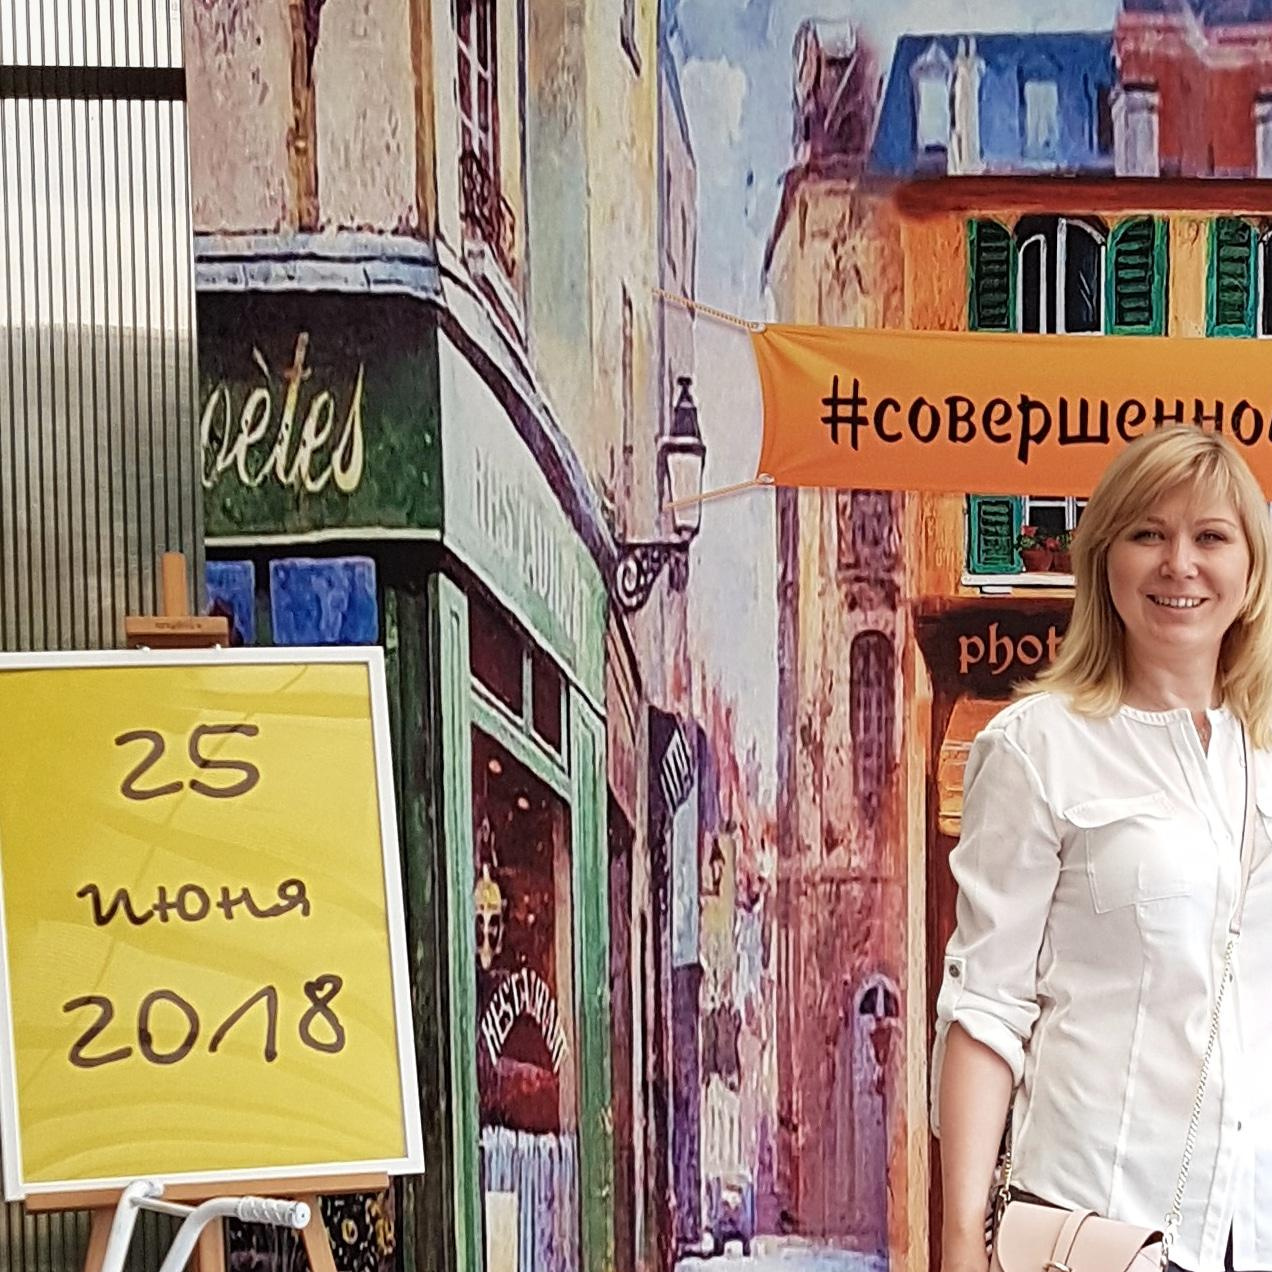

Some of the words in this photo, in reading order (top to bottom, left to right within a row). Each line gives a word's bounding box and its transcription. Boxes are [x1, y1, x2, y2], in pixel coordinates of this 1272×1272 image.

[114, 722, 260, 801] 25
[76, 877, 311, 927] июня
[62, 973, 346, 1069] 2018
